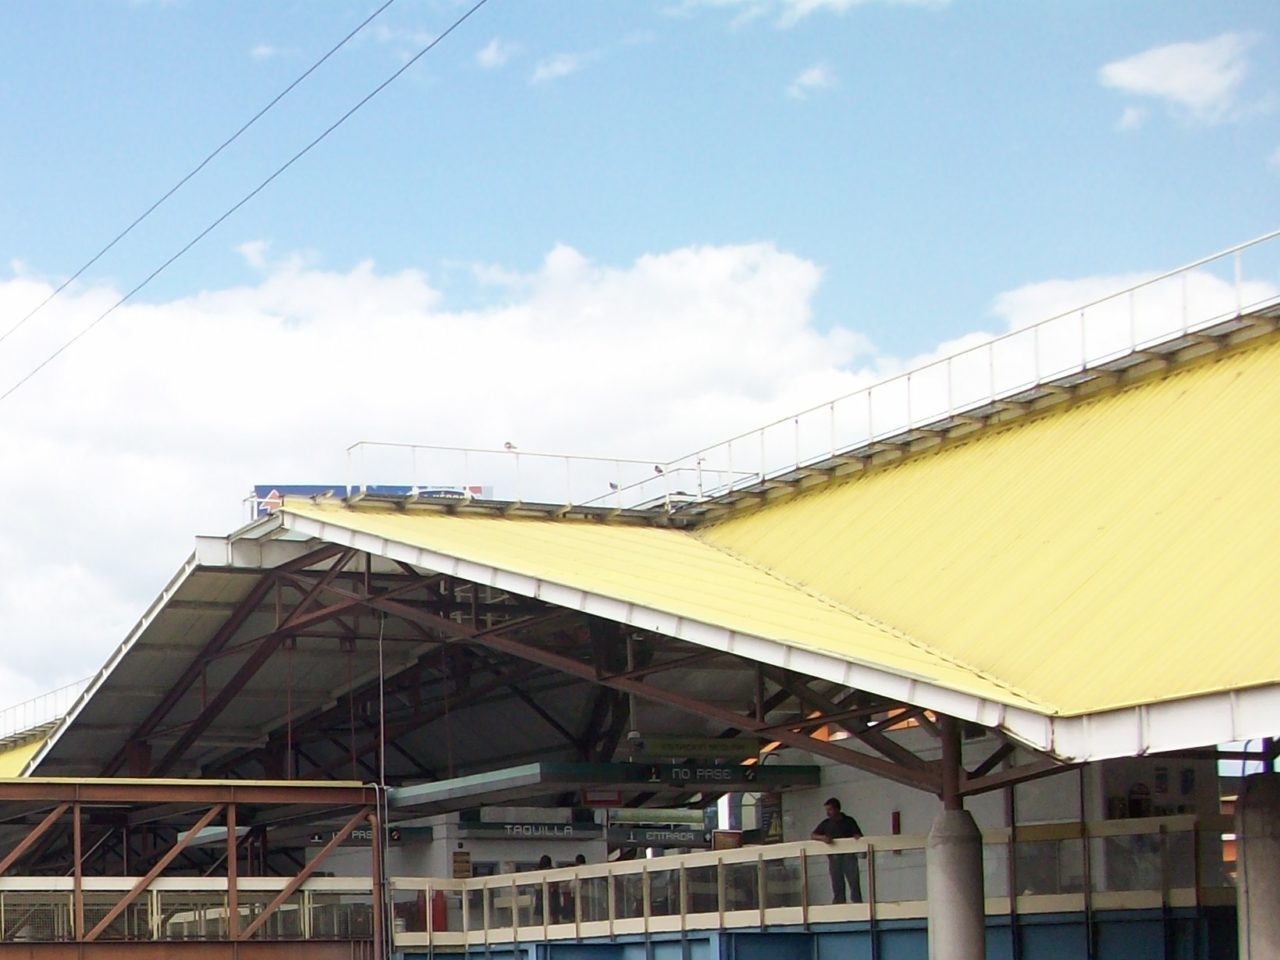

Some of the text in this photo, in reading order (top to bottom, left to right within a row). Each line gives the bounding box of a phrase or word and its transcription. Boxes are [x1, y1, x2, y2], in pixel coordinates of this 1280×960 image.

[672, 768, 732, 779] NO PASE
[351, 830, 373, 839] PAS
[504, 824, 573, 836] TAQUILLA
[645, 831, 695, 841] ENTRADA
